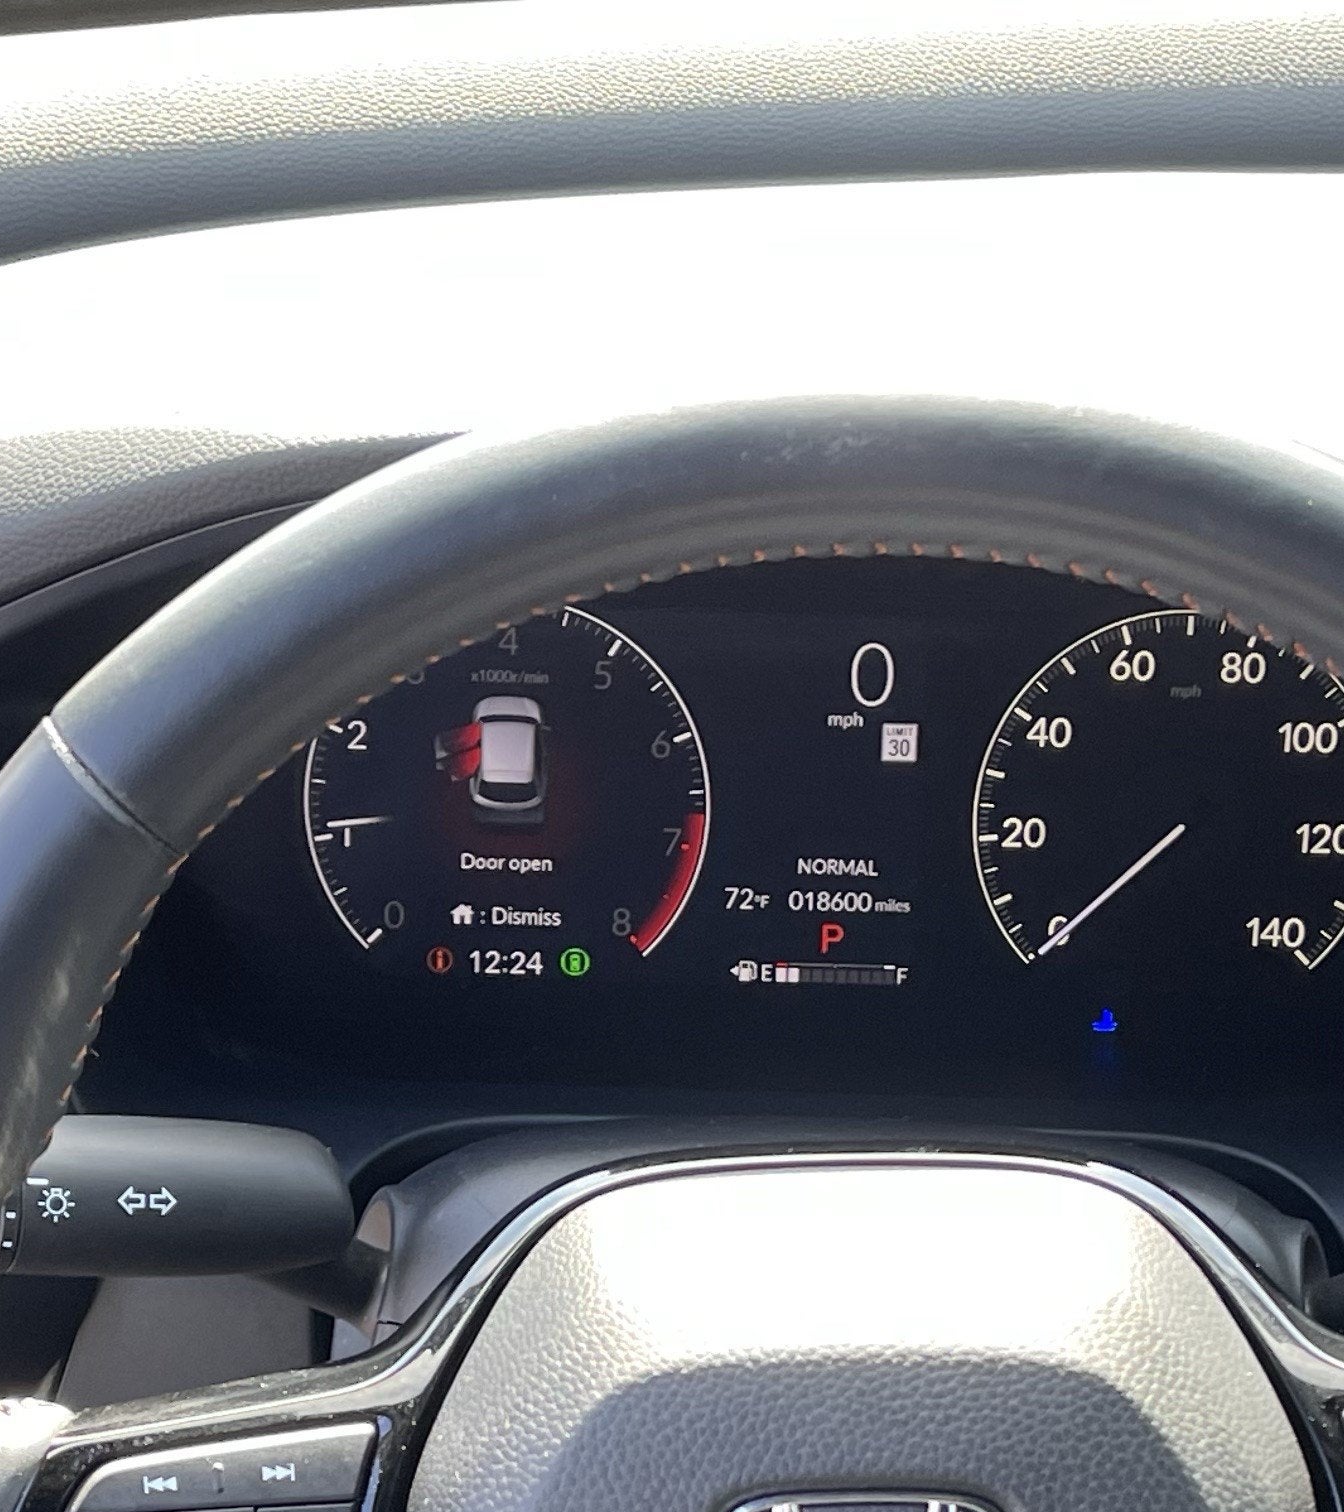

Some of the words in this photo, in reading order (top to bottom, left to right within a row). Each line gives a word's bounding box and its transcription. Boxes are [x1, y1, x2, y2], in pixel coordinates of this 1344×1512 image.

[498, 626, 519, 656] 4
[592, 661, 613, 690] 5
[850, 642, 895, 708] 0
[1109, 649, 1156, 684] 60
[1219, 650, 1266, 685] 80
[1169, 683, 1203, 702] mph
[826, 711, 865, 730] mph
[885, 727, 914, 737] LIMIT
[1026, 716, 1073, 750] 40
[346, 720, 369, 751] 2
[650, 733, 672, 760] 6
[887, 738, 911, 758] 30
[1278, 720, 1338, 754] 100
[662, 828, 683, 857] 7
[1000, 816, 1047, 850] 20
[459, 851, 505, 874] Door
[507, 854, 553, 876] open
[796, 857, 878, 878] NORMAL
[383, 900, 406, 929] 0
[490, 904, 562, 928] Dismiss
[788, 889, 873, 914] 018600
[874, 896, 911, 913] miles
[611, 908, 632, 937] 8
[1245, 916, 1306, 949] 140
[820, 924, 844, 953] P
[468, 949, 543, 976] 12:24
[760, 964, 773, 982] E
[896, 966, 908, 985] F
